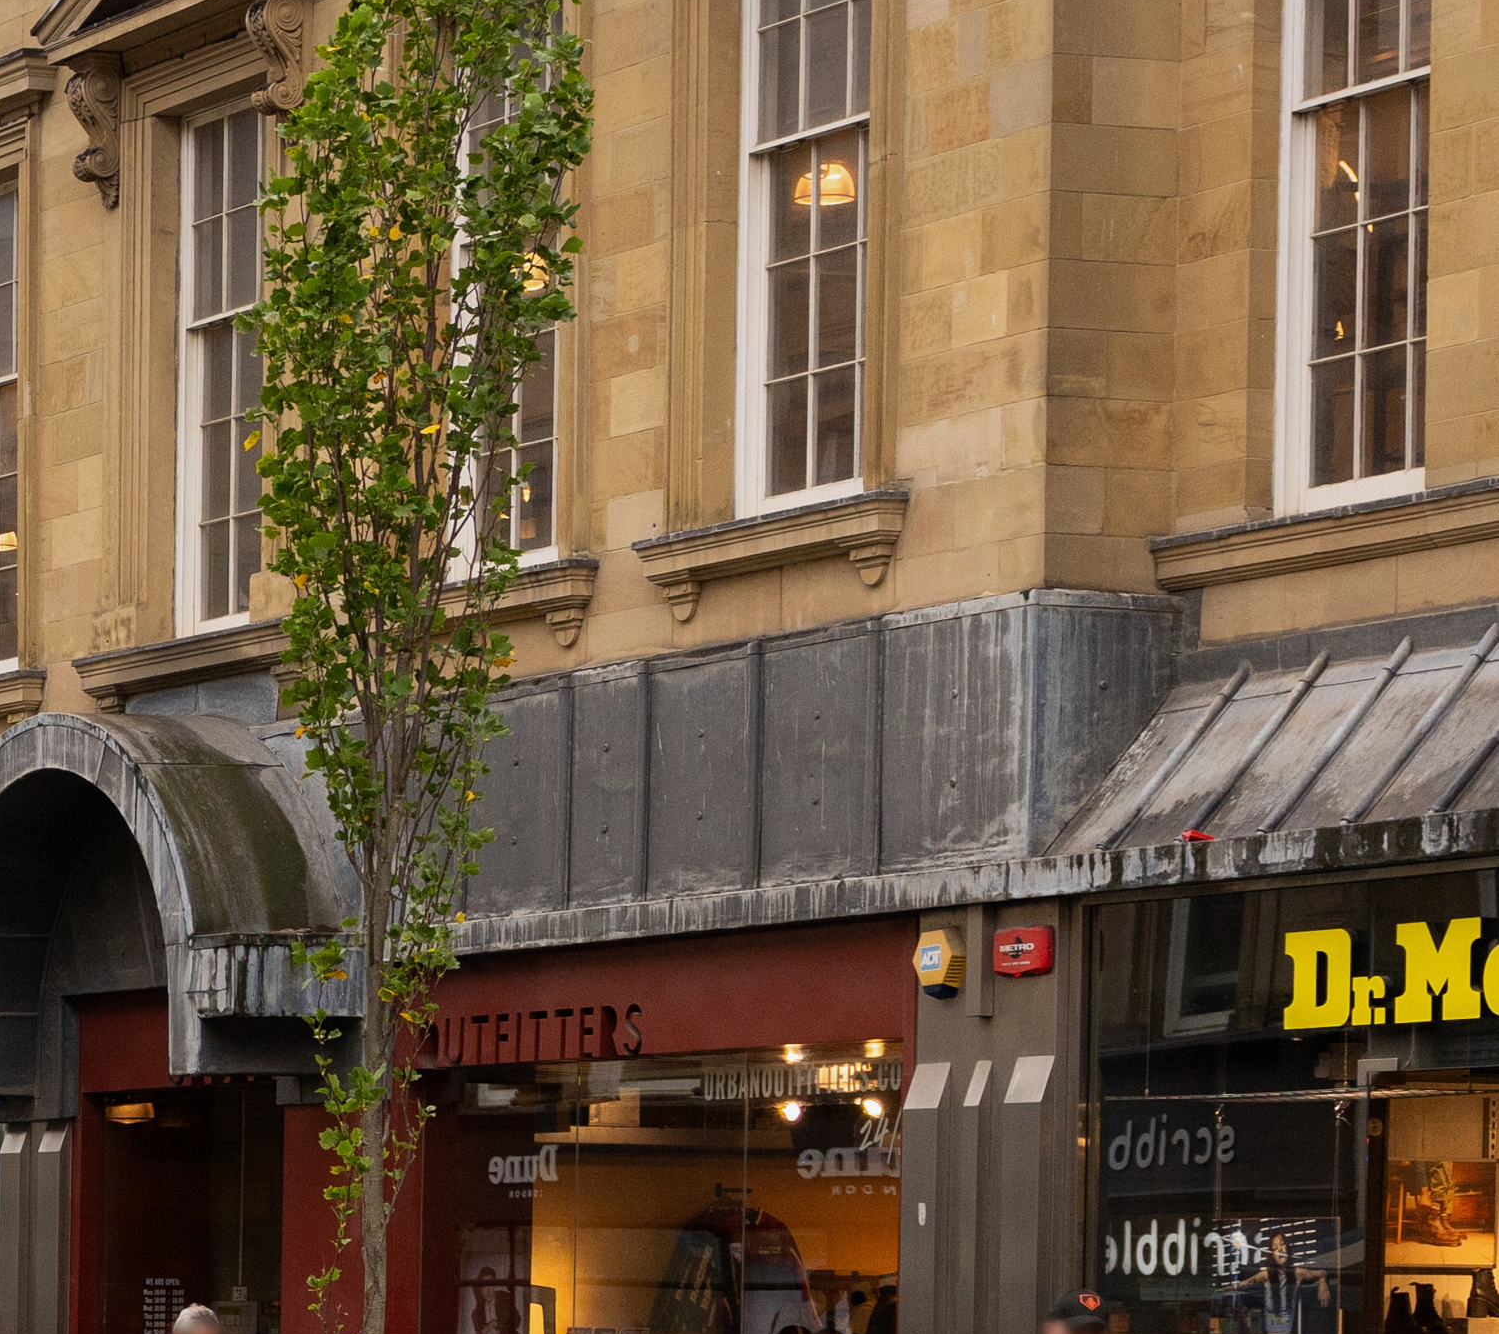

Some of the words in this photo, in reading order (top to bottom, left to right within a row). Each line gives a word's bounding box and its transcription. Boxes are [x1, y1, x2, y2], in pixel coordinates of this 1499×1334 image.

[920, 951, 940, 968] ADT
[999, 942, 1035, 953] METRO
[1283, 928, 1387, 1030] Dr.
[424, 1003, 643, 1067] OUTFITTERS
